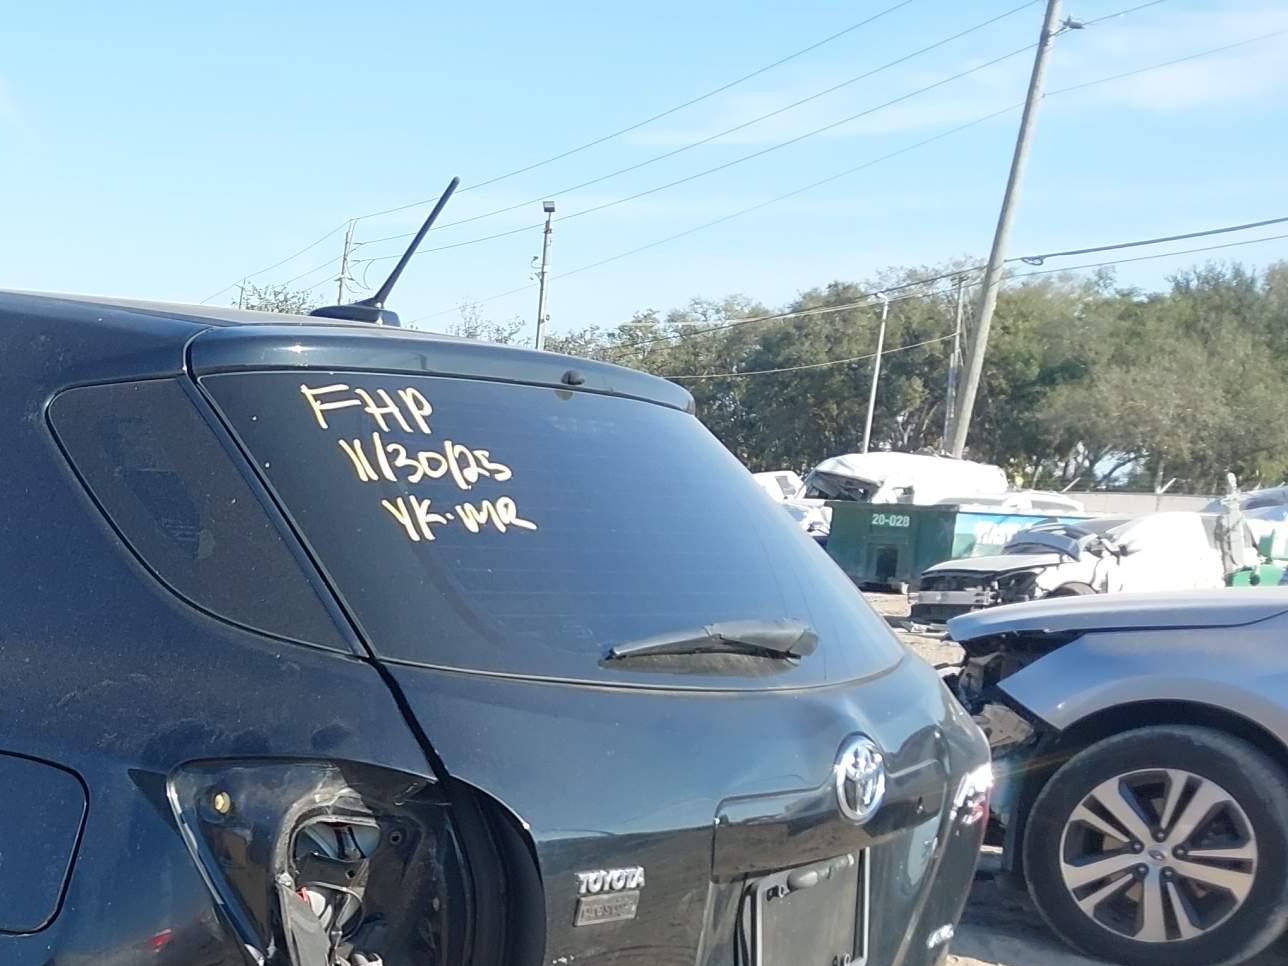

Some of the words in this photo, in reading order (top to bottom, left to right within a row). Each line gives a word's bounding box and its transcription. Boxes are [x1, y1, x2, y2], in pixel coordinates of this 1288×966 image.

[300, 384, 433, 434] FHP
[338, 432, 512, 489] 11/30/25
[871, 513, 910, 527] 20-028
[574, 866, 645, 893] TOYOTA
